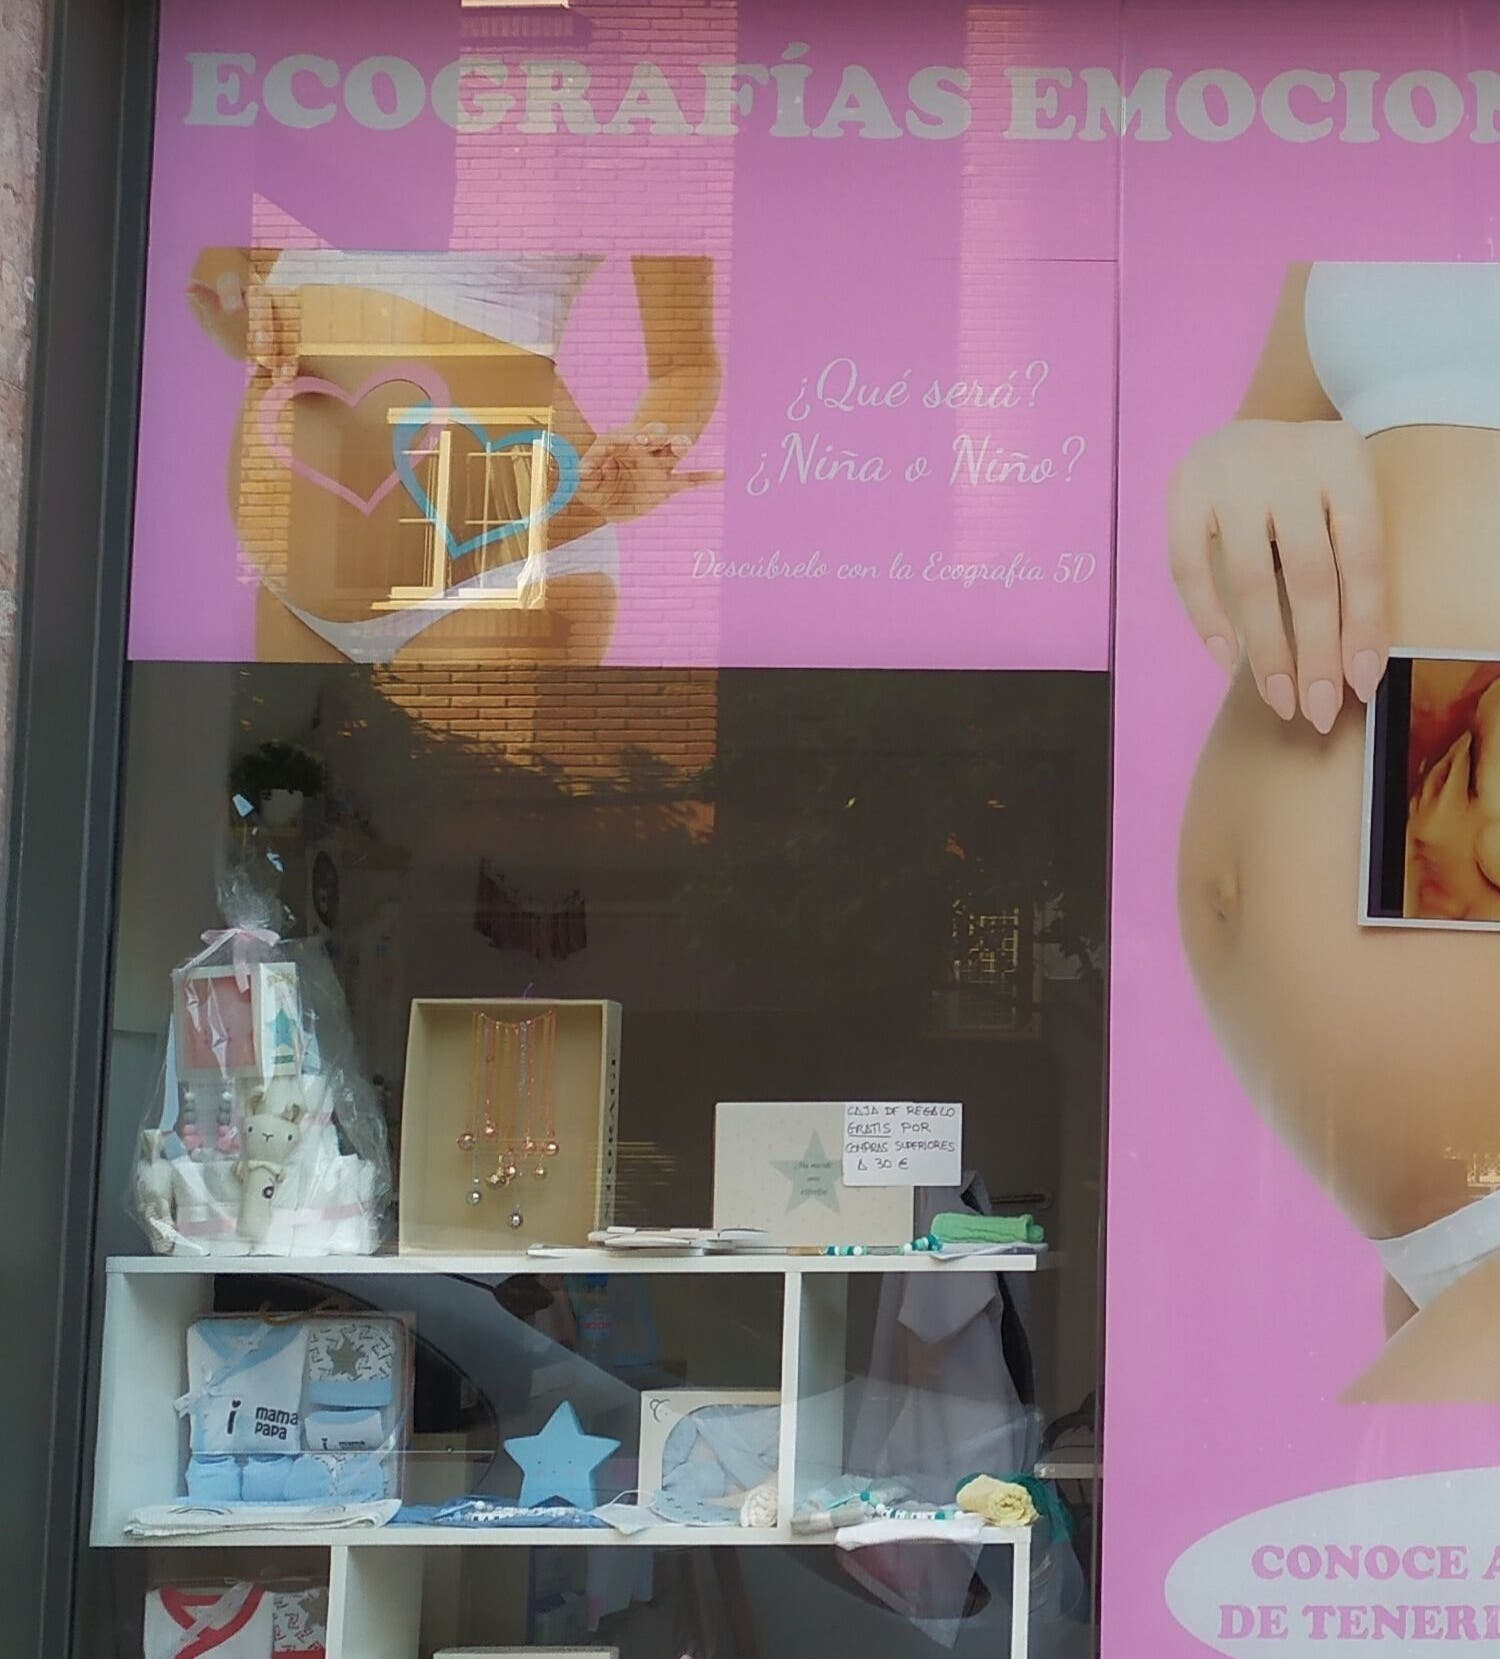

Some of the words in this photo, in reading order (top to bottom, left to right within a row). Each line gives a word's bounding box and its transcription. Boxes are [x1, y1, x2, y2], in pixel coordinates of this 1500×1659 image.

[183, 42, 973, 140] ECOGRAFÍAS
[787, 357, 912, 421] ¿Qué
[922, 360, 1049, 409] será?
[745, 432, 892, 496] ¿Niña
[904, 455, 932, 482] o
[949, 434, 1087, 487] Niño?
[692, 547, 829, 581] Descúbrelo
[837, 564, 877, 580] con
[889, 551, 914, 580] la
[922, 551, 1045, 589] Ecografía
[1053, 553, 1097, 583] 5D
[847, 1105, 879, 1117] CAJA
[906, 1105, 955, 1117] REGALO
[847, 1121, 892, 1136] GRATIS
[901, 1121, 932, 1133] POR
[846, 1141, 889, 1154] COMPRAS
[895, 1139, 956, 1152] SUPERIORES
[857, 1158, 868, 1171] A
[875, 1158, 892, 1169] 30
[897, 1158, 910, 1170] €
[255, 1406, 299, 1426] mama
[254, 1421, 288, 1441] papa
[1250, 1544, 1468, 1581] CONOCE
[1218, 1604, 1289, 1640] DE
